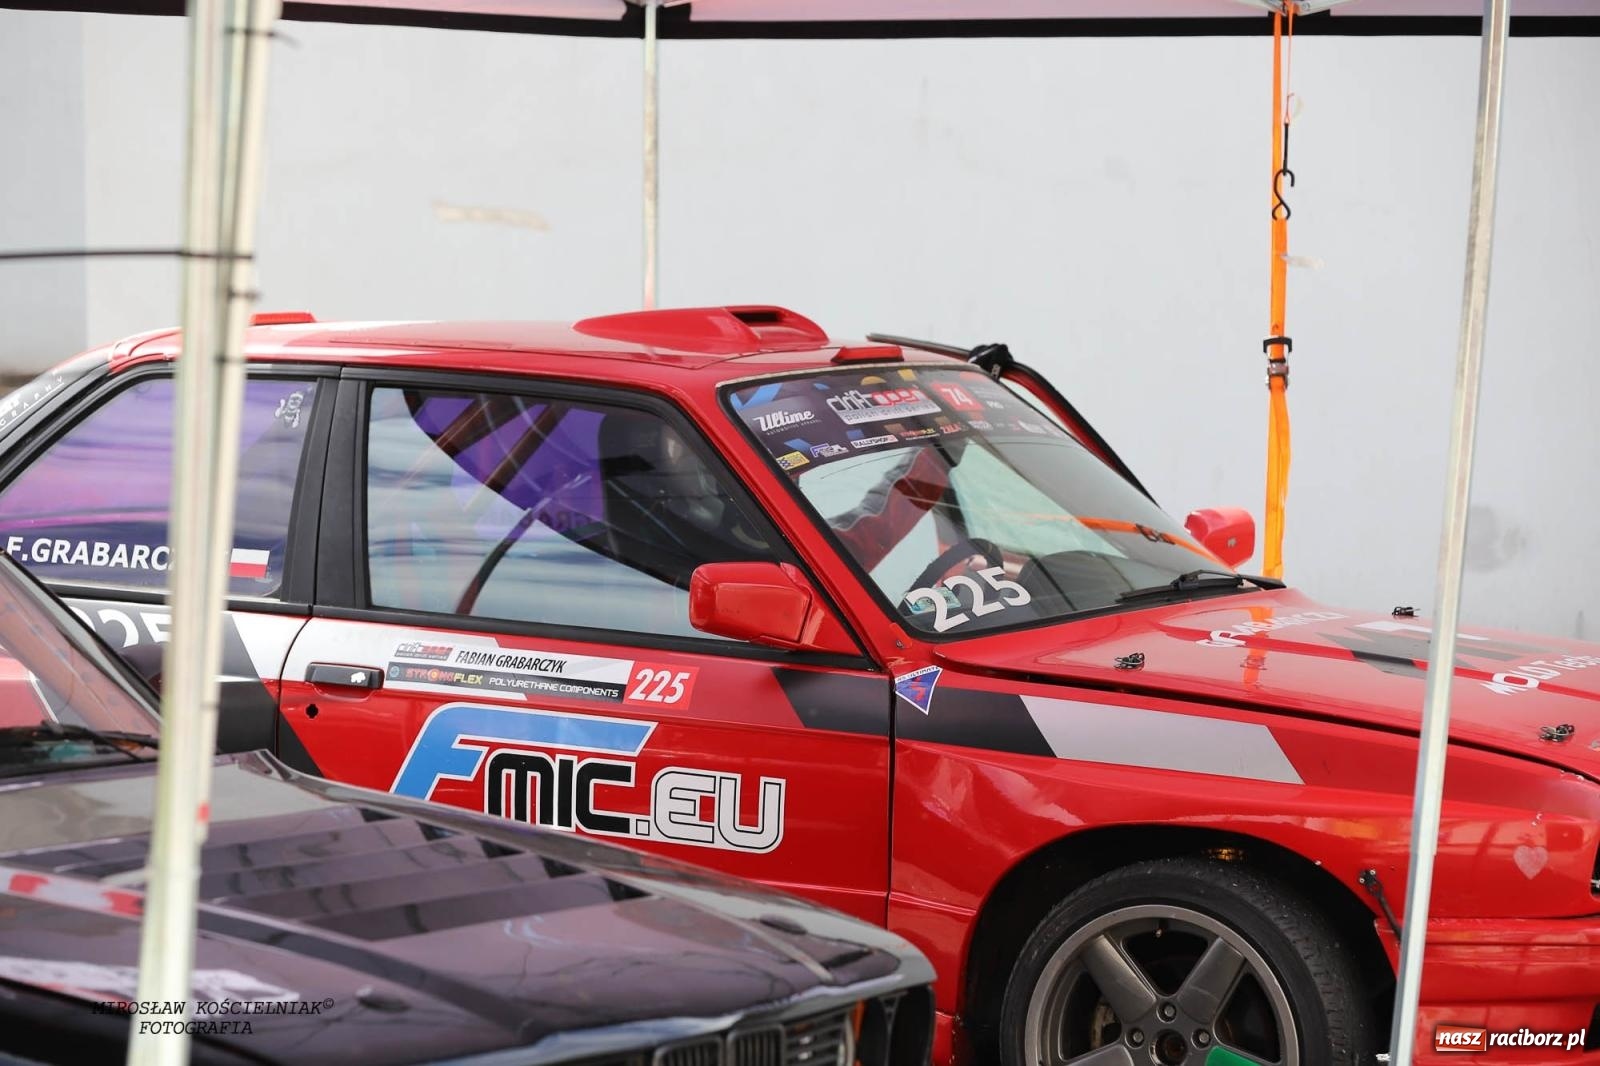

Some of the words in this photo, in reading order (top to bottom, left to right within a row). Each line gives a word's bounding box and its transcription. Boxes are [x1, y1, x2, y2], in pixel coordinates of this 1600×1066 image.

[6, 536, 176, 571] F.GRABARC
[905, 566, 1031, 632] 225
[455, 650, 496, 667] FABIAN
[496, 654, 566, 674] GRABARCZYK
[405, 667, 483, 685] STRONGFLEX
[489, 677, 558, 691] POLYURETHANE
[559, 684, 620, 697] COMPONENTS
[629, 669, 691, 704] 225
